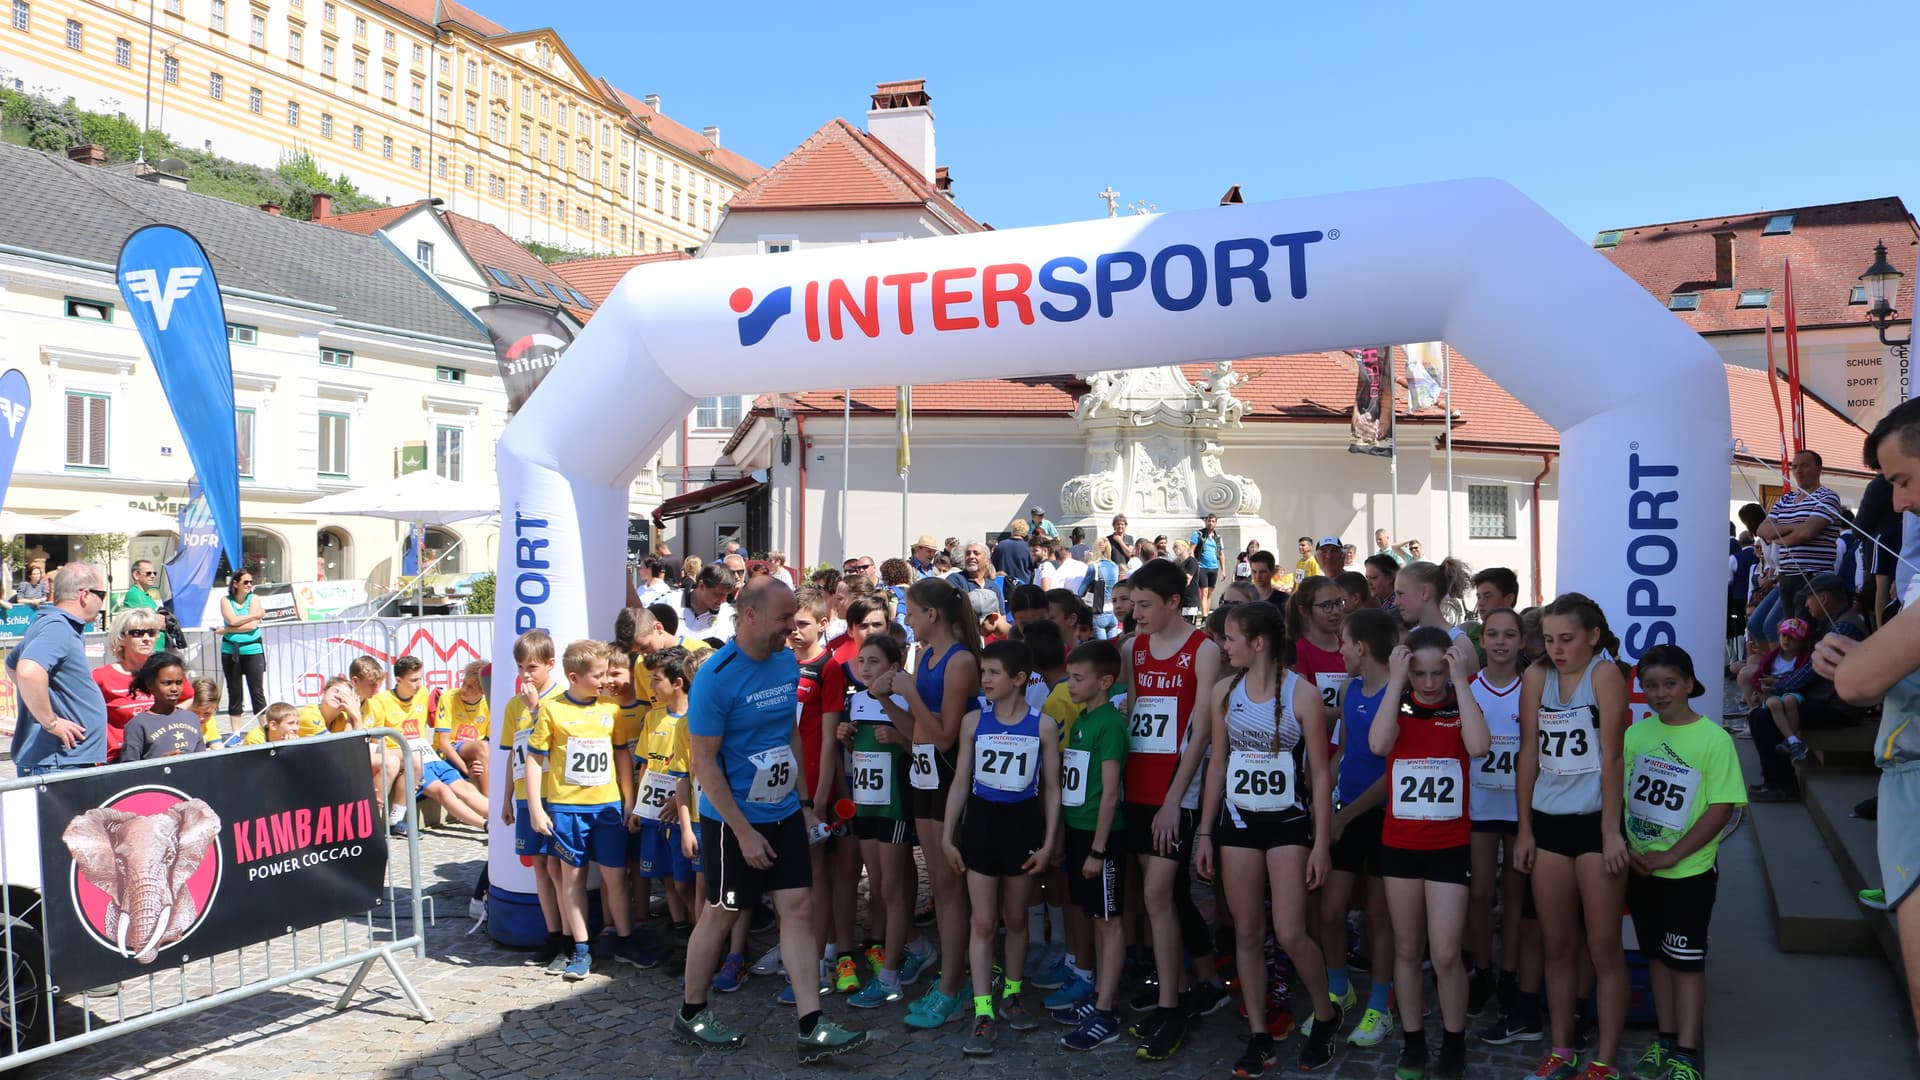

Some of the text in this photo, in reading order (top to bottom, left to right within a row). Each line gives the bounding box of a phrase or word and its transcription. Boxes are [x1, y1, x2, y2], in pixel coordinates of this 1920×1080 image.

[804, 230, 1324, 343] INTERSPORT
[1846, 357, 1883, 367] SCHUHE
[1847, 378, 1879, 387] SPORT
[1847, 399, 1876, 408] MODE
[1625, 453, 1679, 662] SPORT
[515, 511, 550, 635] PORT
[753, 682, 794, 701] INTERSPORT
[150, 722, 198, 740] JUST ANOTHER
[1131, 713, 1170, 738] 237
[1539, 728, 1588, 757] 273
[571, 752, 608, 773] 209
[767, 762, 790, 787] 35
[981, 749, 1027, 776] 271
[1649, 760, 1690, 775] INTERSPORT
[853, 767, 884, 790] 245
[1234, 769, 1287, 796] 269
[1400, 776, 1455, 803] 242
[1633, 774, 1687, 812] 285
[233, 799, 373, 865] KAMBAKU
[249, 845, 363, 882] POWER COCCAO
[1665, 931, 1688, 948] NYC
